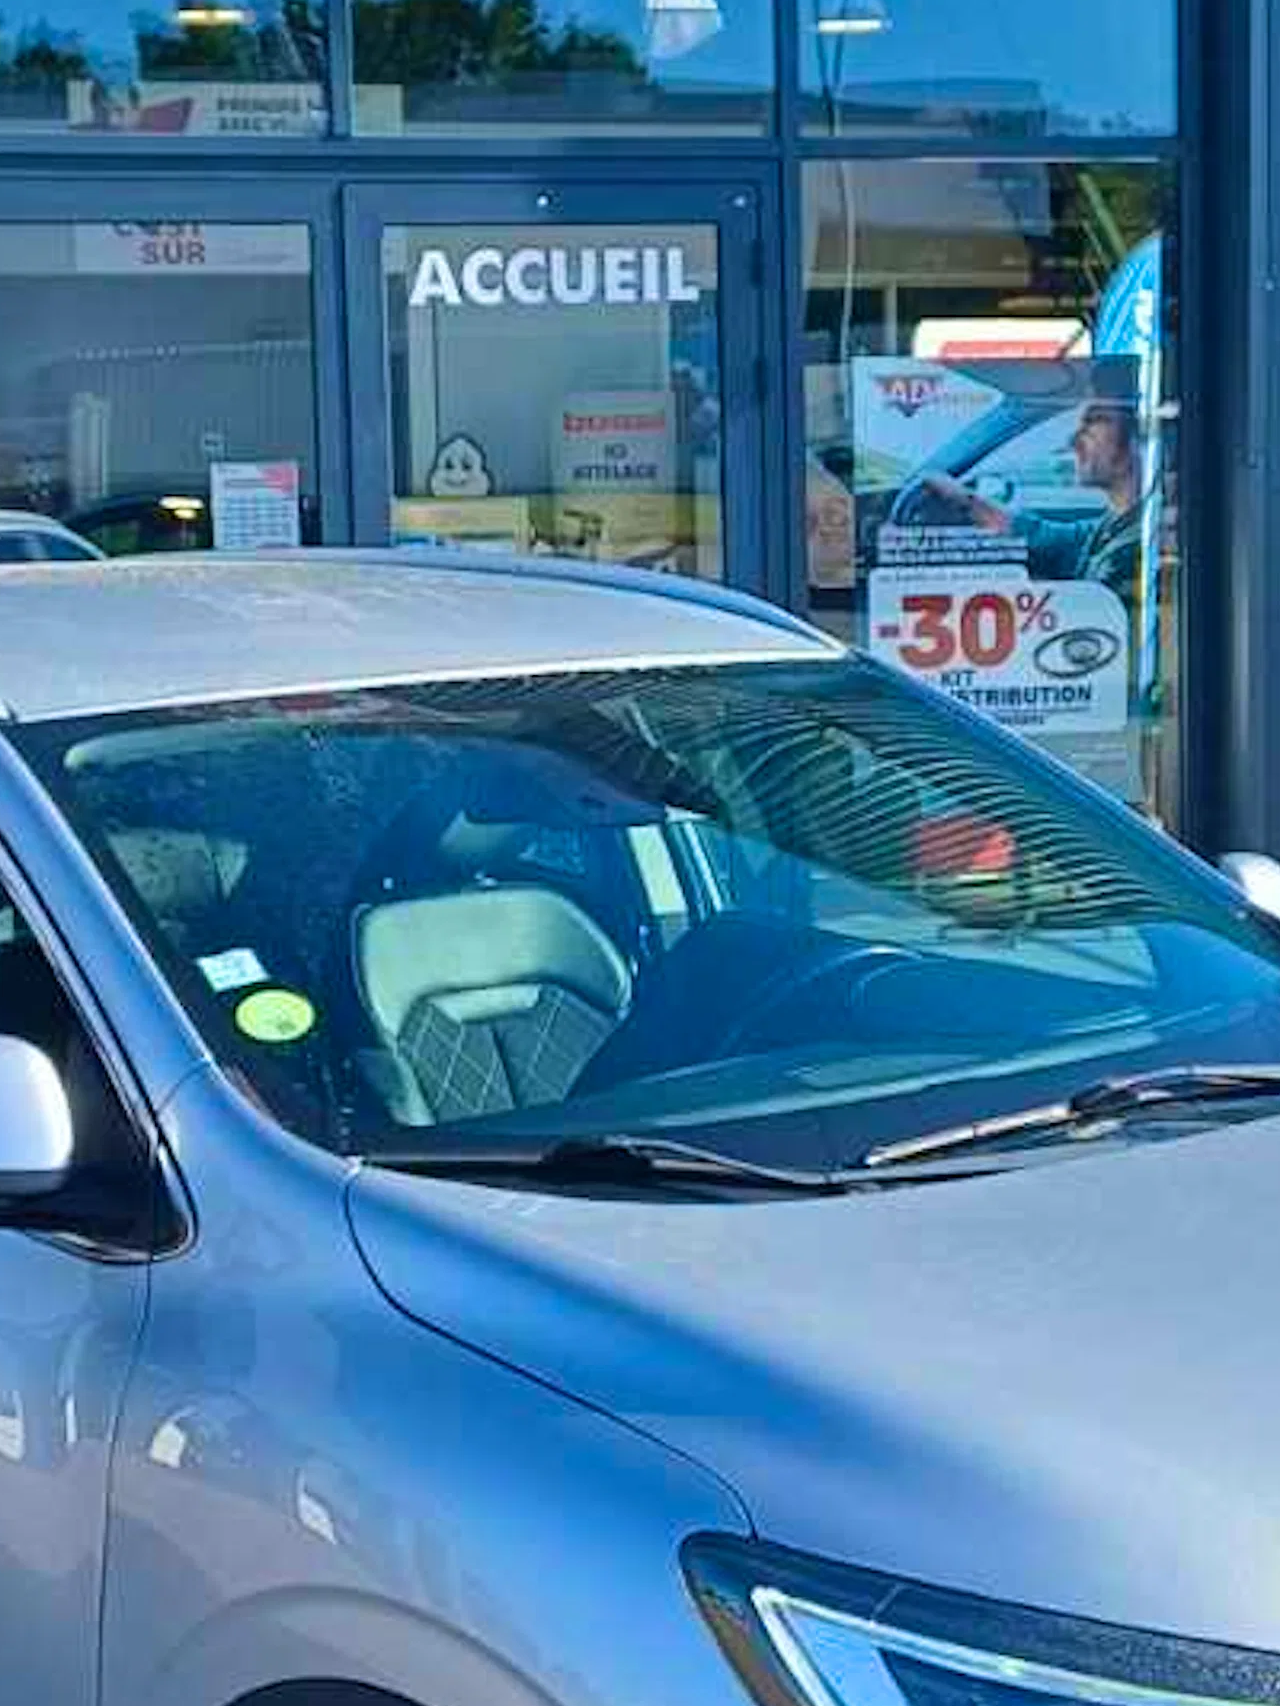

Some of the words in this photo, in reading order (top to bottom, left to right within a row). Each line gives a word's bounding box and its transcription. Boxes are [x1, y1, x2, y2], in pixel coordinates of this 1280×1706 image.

[408, 246, 701, 307] ACCUEIL
[940, 670, 978, 687] KIT
[950, 682, 1093, 707] STRIBUTION
